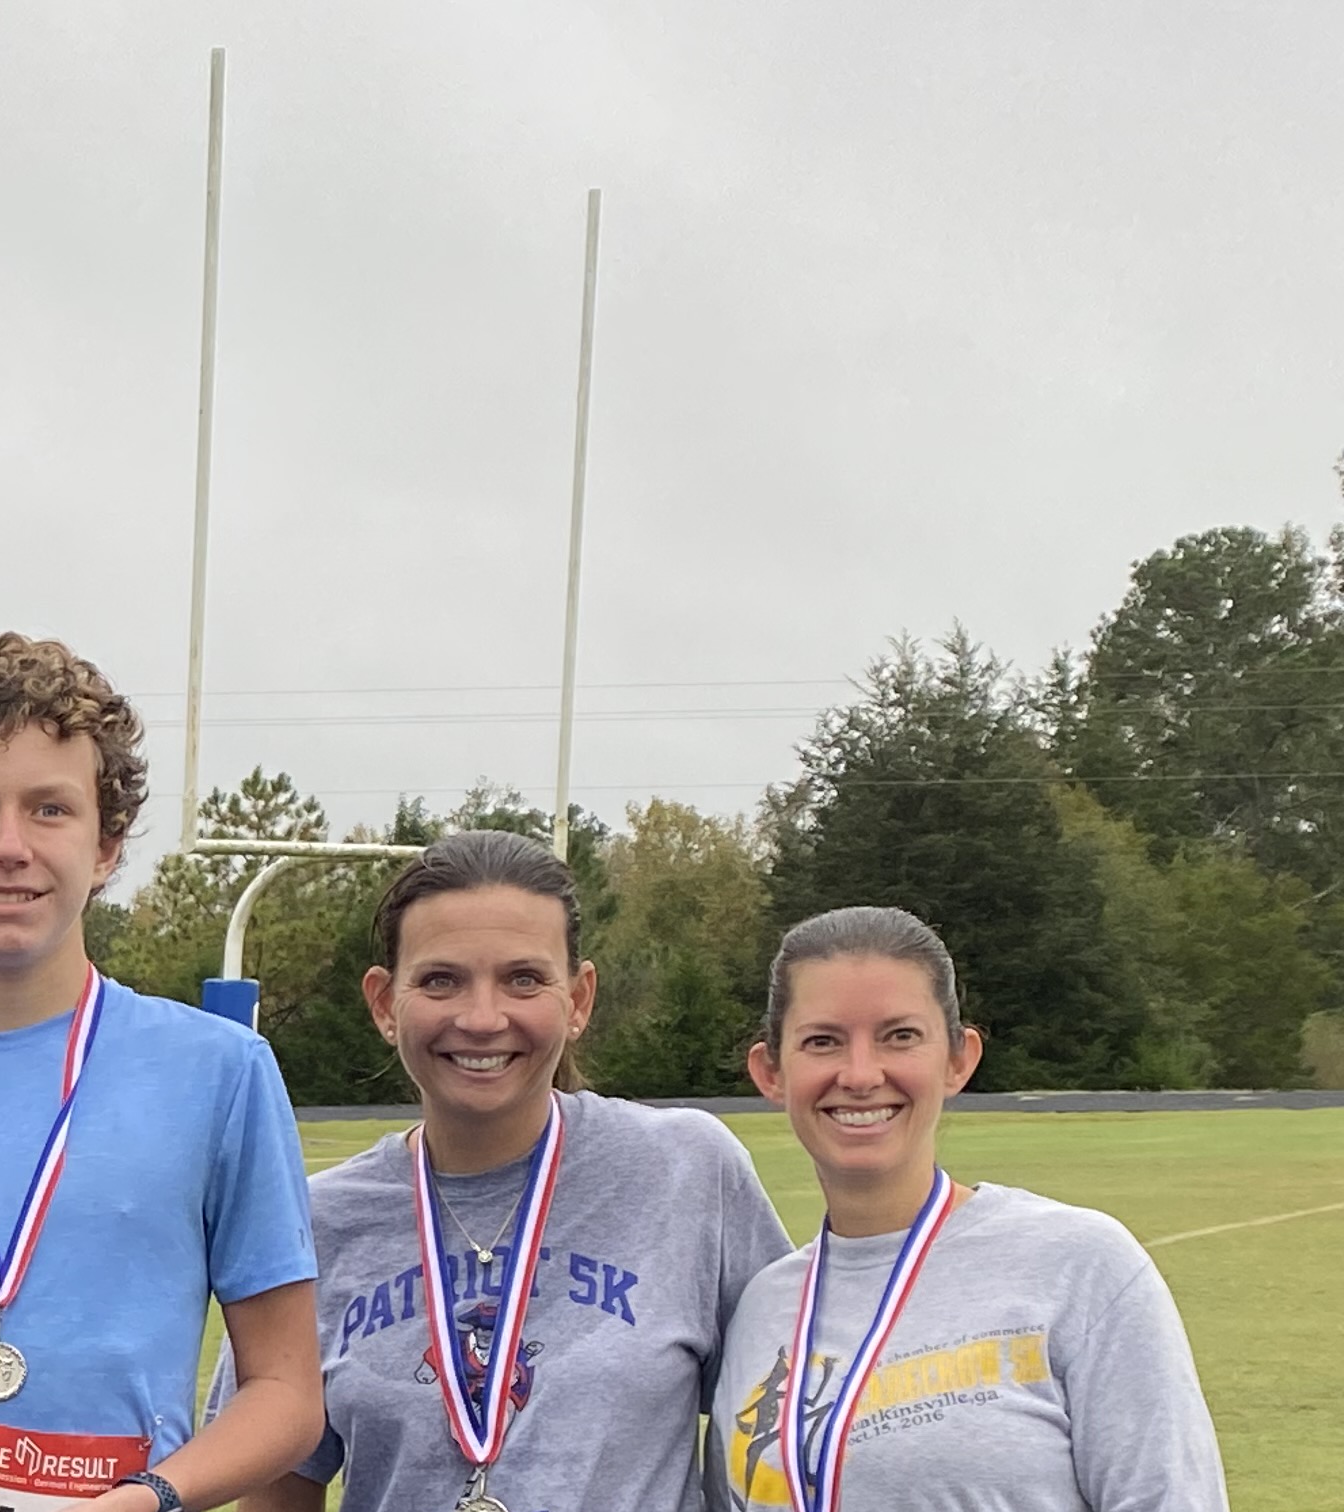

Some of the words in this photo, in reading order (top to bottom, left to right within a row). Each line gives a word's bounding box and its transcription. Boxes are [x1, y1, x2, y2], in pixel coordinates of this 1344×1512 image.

[972, 1323, 1045, 1341] commerce
[902, 1409, 944, 1430] 2016
[42, 1455, 119, 1479] RESULT
